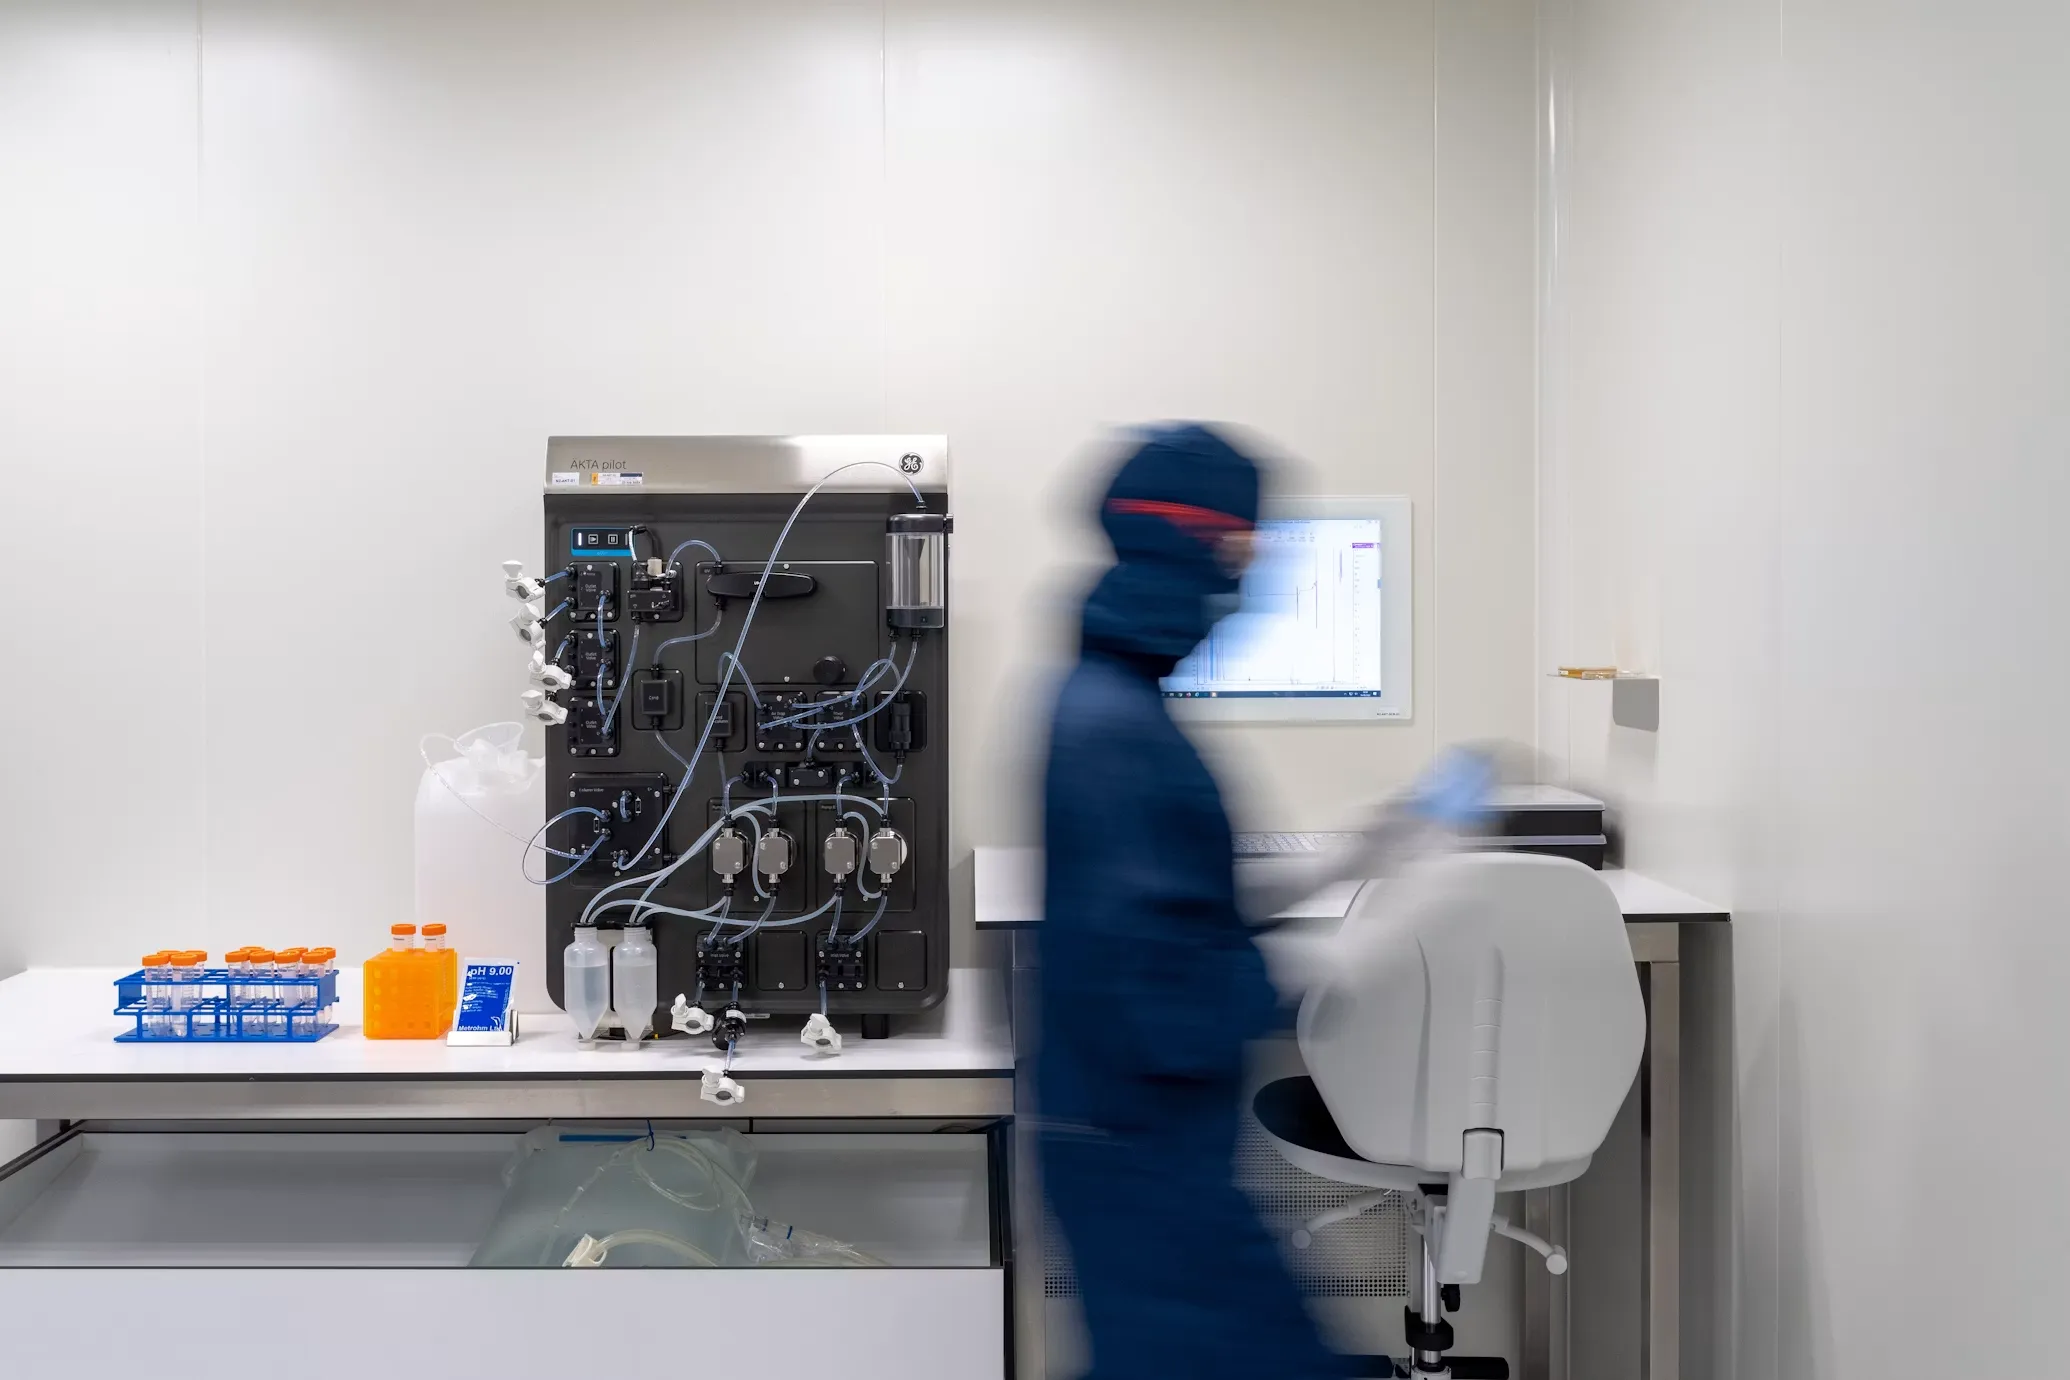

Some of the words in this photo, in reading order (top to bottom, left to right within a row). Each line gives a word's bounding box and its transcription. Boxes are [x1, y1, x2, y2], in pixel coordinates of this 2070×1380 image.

[570, 458, 599, 470] ÄKTA
[602, 459, 627, 472] pilot
[470, 966, 486, 976] pH
[489, 966, 512, 976] 9.00
